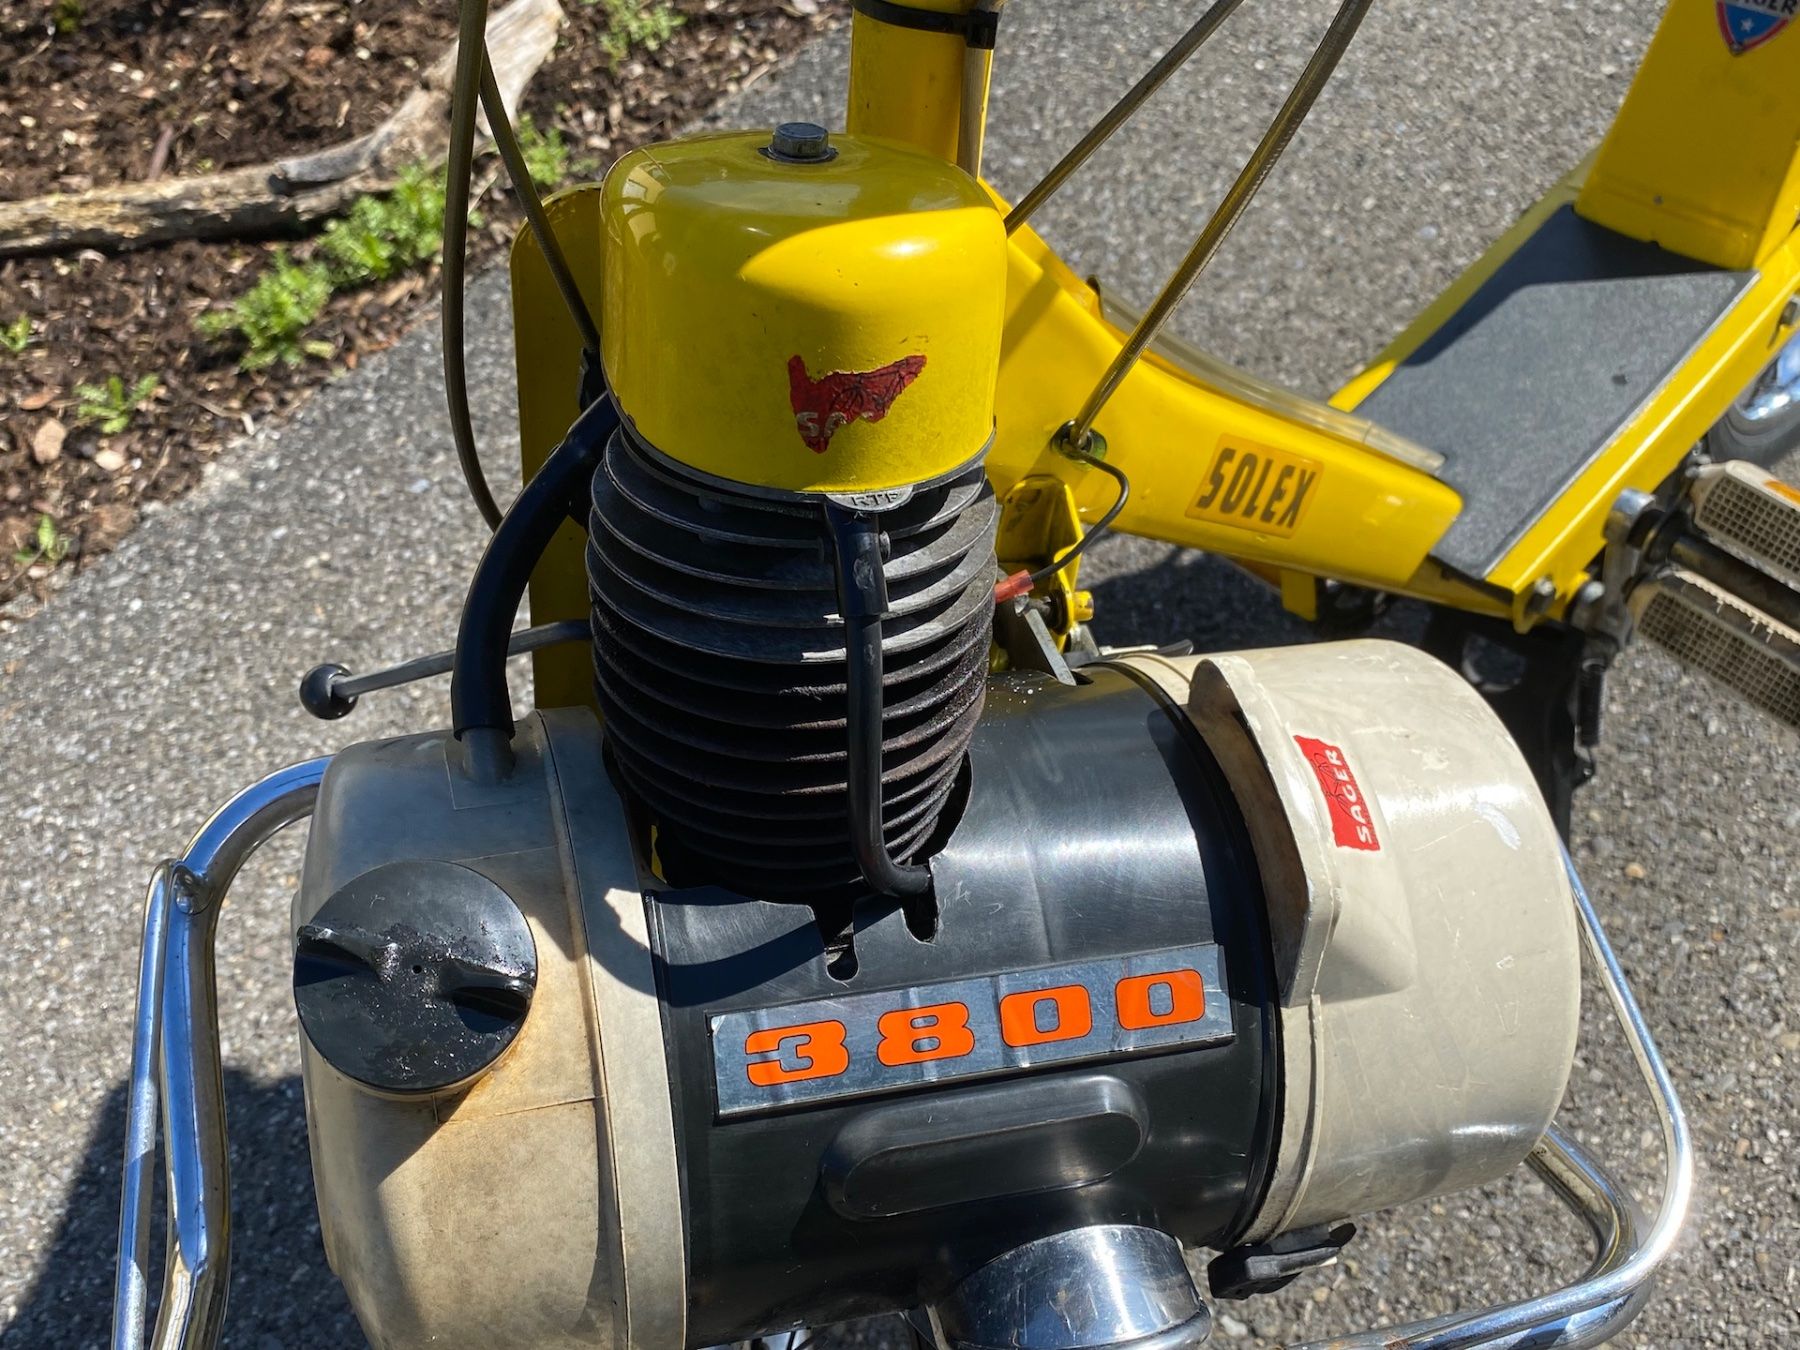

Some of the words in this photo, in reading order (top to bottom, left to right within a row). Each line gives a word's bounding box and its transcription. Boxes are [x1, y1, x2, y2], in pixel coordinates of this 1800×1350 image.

[1195, 447, 1317, 529] SOLEX
[1324, 749, 1373, 845] SAGER
[744, 968, 1206, 1087] 3800
